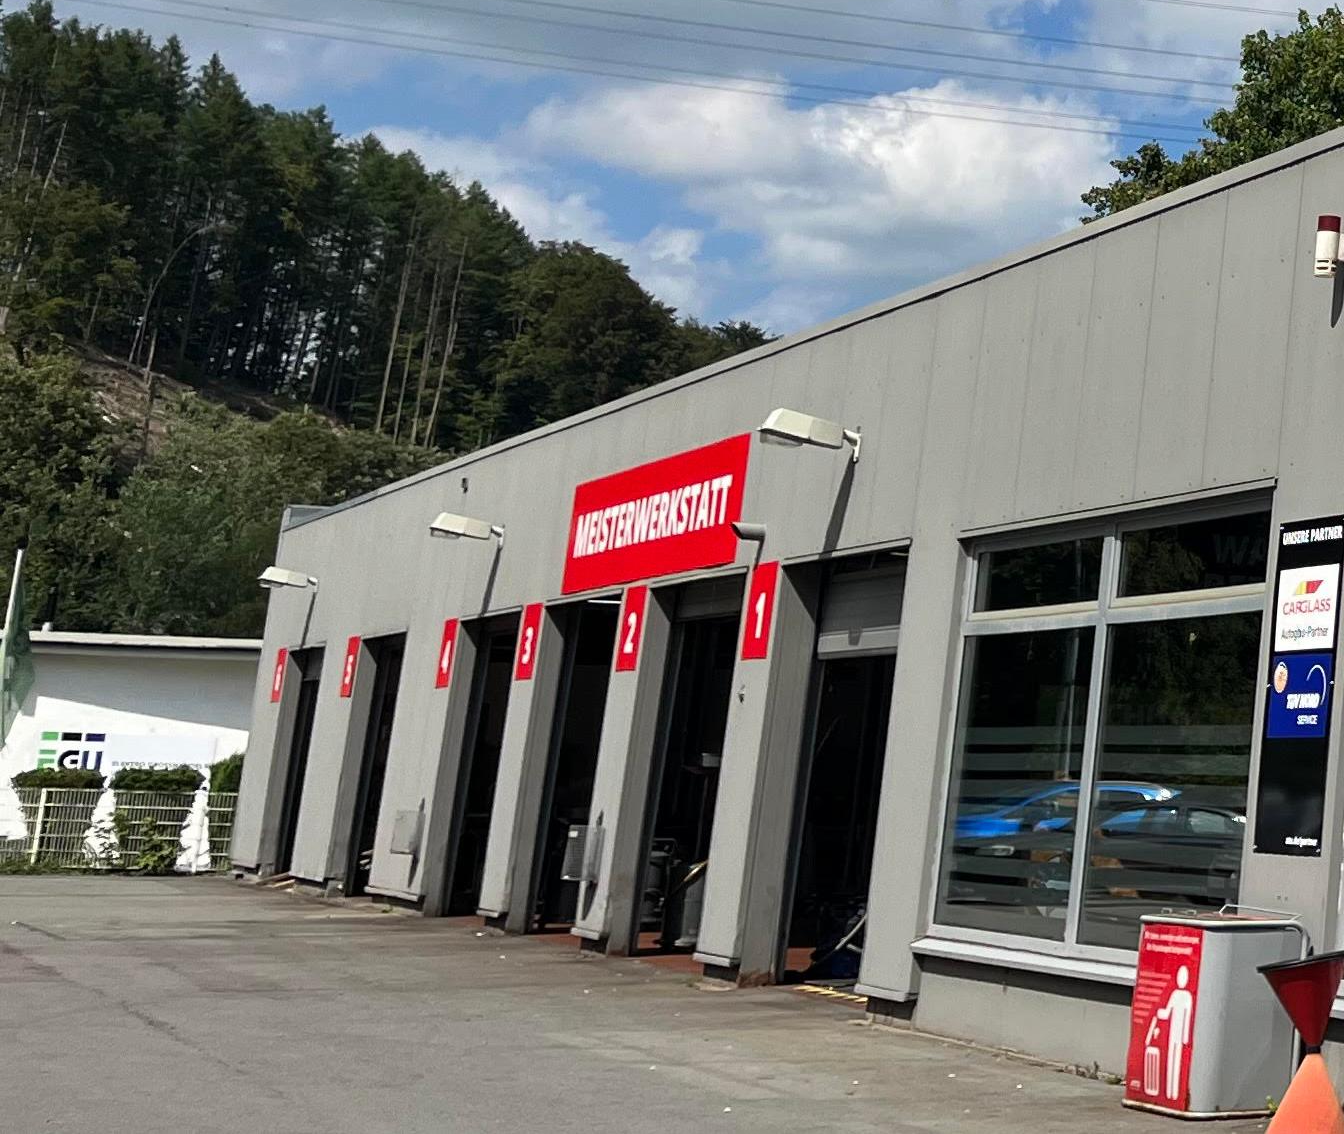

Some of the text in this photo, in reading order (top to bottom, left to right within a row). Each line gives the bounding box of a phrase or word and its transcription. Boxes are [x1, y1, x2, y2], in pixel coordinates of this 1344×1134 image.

[572, 473, 734, 558] MEISTERWERKSTATT
[1282, 525, 1343, 546] UNSERE PARTNER
[754, 592, 767, 639] 1
[1282, 597, 1332, 616] CARGLASS
[521, 626, 534, 665] 3
[623, 612, 637, 654] 2
[440, 640, 452, 674] 4
[1297, 714, 1319, 725] SERVICE
